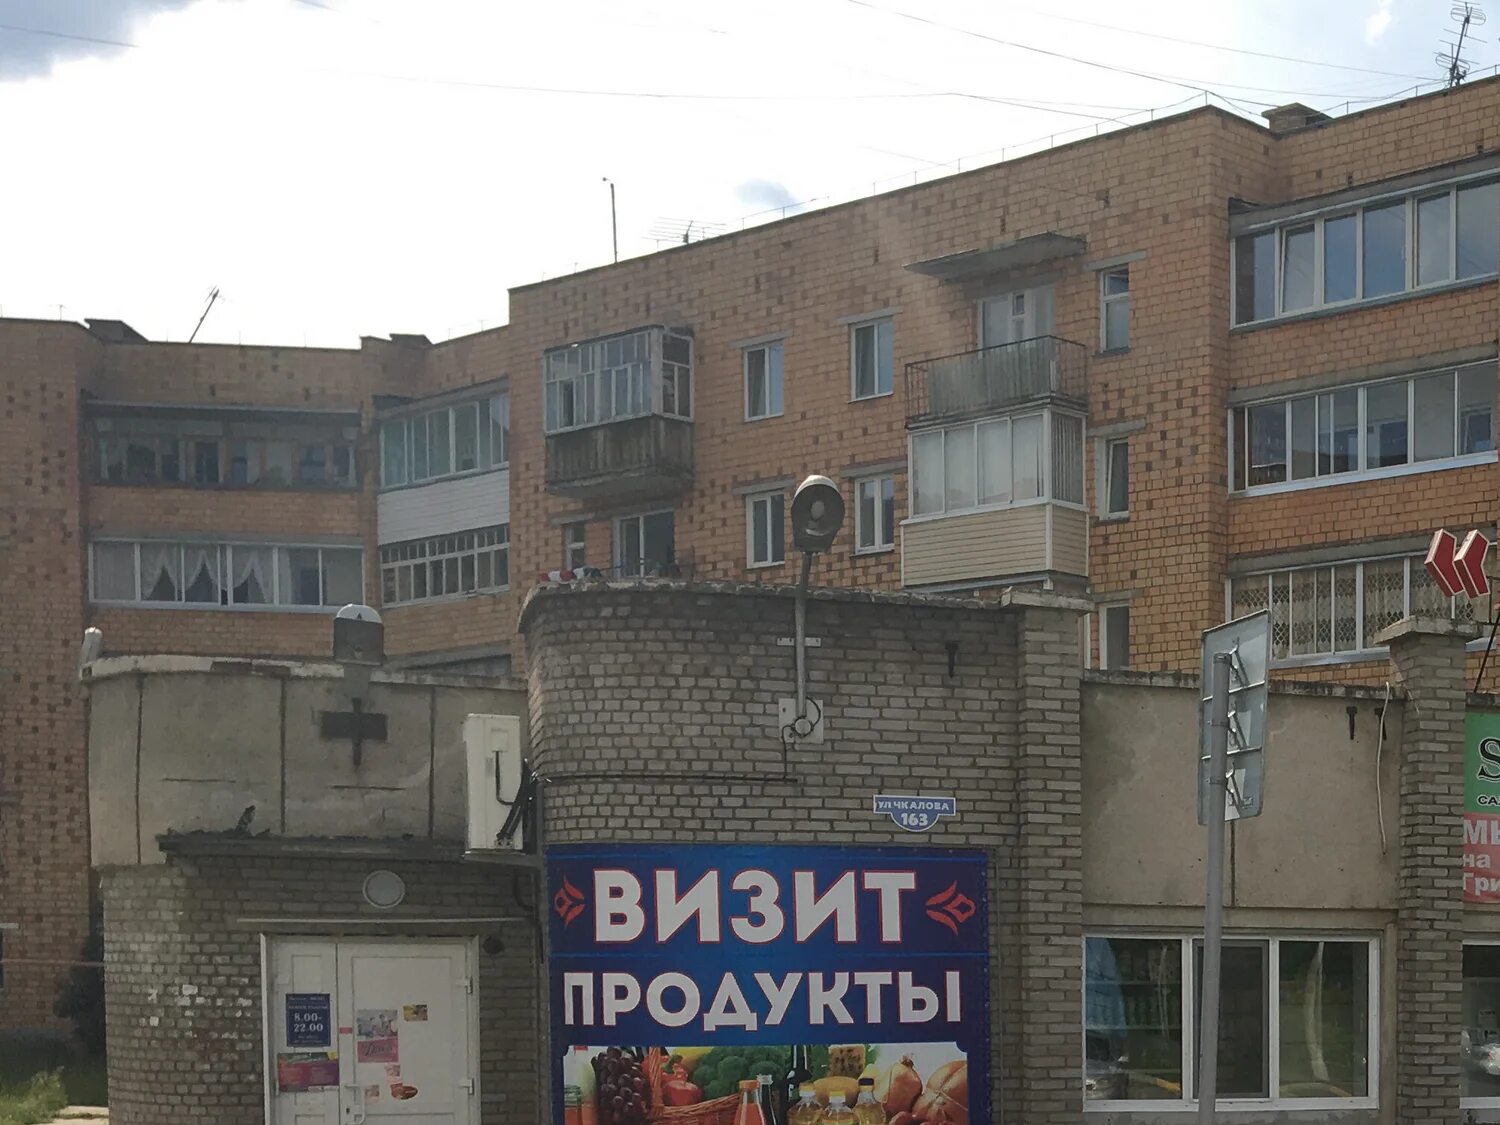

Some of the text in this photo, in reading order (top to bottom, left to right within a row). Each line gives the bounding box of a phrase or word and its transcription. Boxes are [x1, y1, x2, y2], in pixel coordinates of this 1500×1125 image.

[901, 812, 929, 826] 163
[1463, 852, 1491, 869] на
[593, 868, 917, 944] ВИЗИТ
[563, 970, 962, 1031] ПРОДУКТЫ
